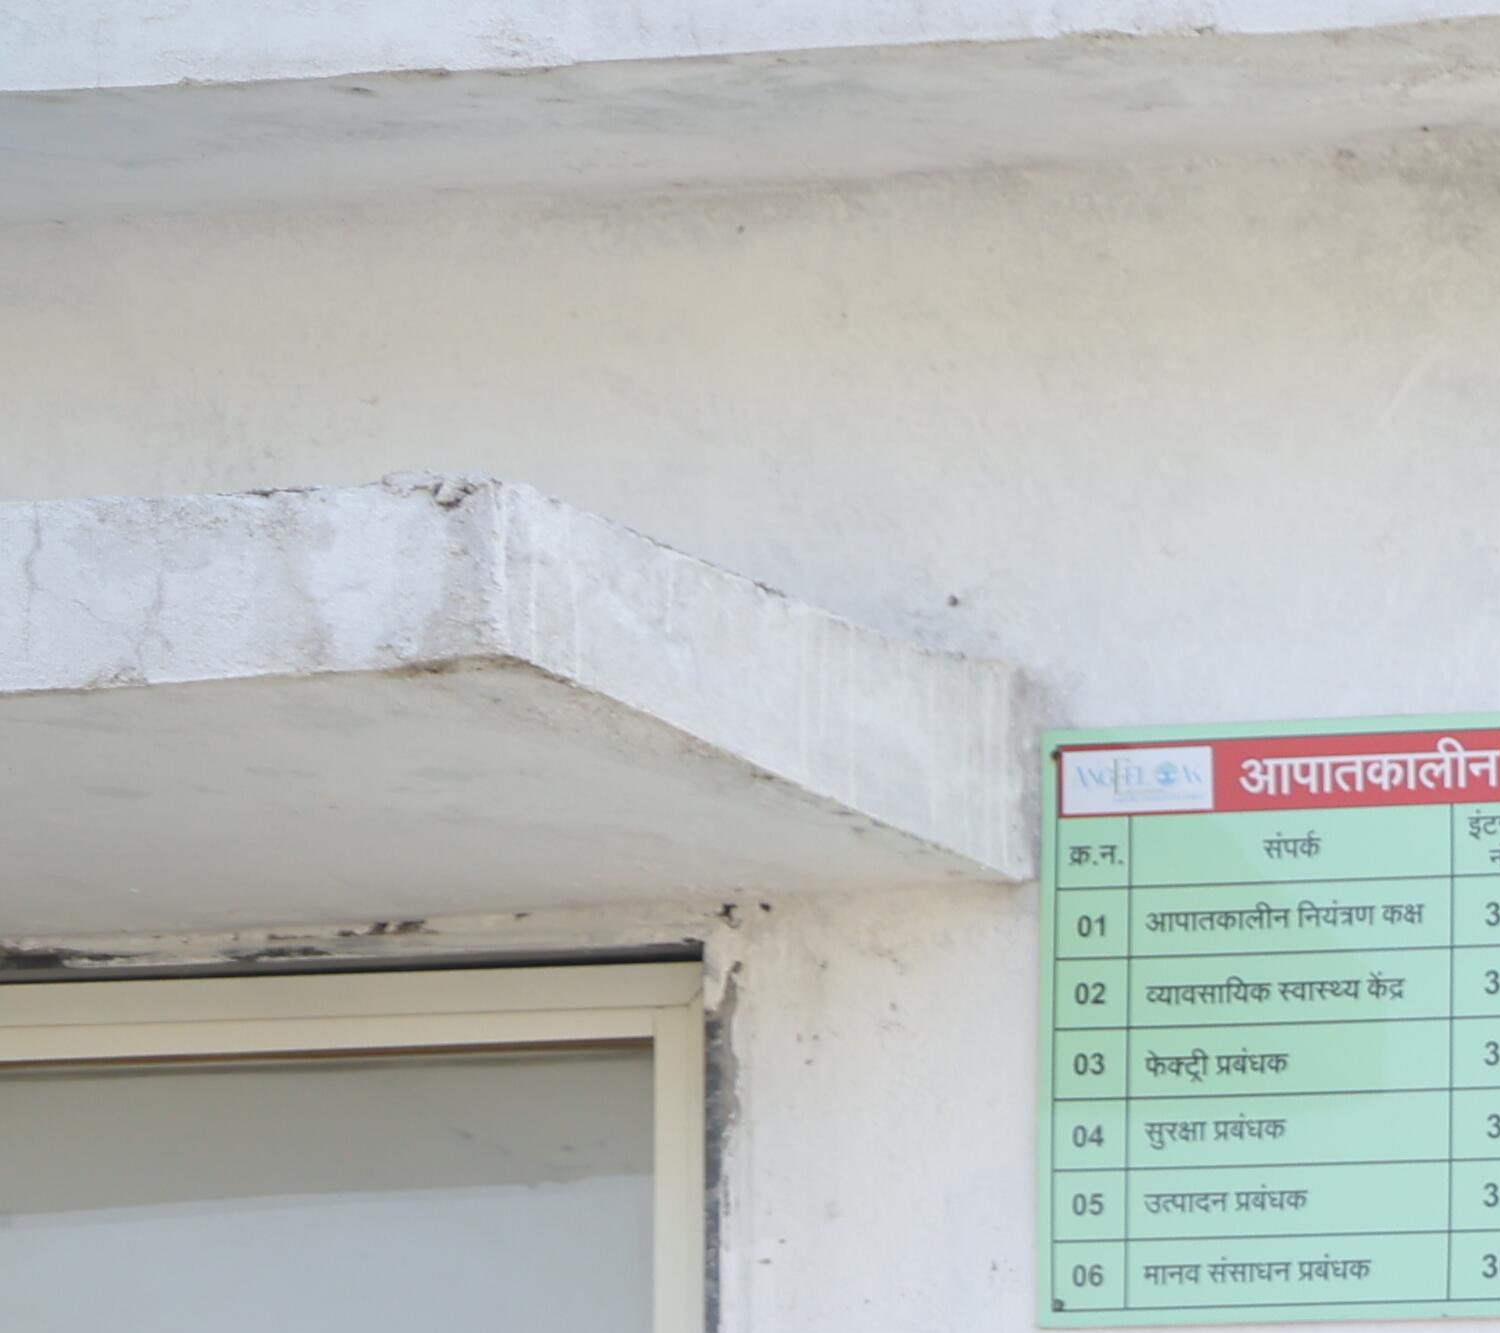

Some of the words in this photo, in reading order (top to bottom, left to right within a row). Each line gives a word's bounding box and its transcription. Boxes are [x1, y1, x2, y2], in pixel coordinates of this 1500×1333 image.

[1262, 829, 1322, 859] संपर्क
[1076, 914, 1106, 939] 01
[1145, 901, 1291, 933] आपातकालीन
[1296, 899, 1376, 929] नियंत्रण
[1381, 903, 1425, 925] कक्ष
[1074, 981, 1107, 1006] 02
[1145, 975, 1273, 1006] व्यावसायिक
[1277, 979, 1362, 1002] स्वास्थ्य
[1366, 971, 1406, 1000] केंद्र
[1073, 1052, 1106, 1076] 03
[1215, 1047, 1289, 1075] प्रबंधक
[1072, 1124, 1105, 1149] 04
[1143, 1120, 1208, 1151] सुरक्षा
[1212, 1112, 1287, 1141] प्रबंधक
[1071, 1192, 1105, 1217] 05
[1143, 1191, 1230, 1215] उत्पादन
[1234, 1183, 1309, 1212] प्रबंधक
[1071, 1263, 1105, 1288] 06
[1142, 1263, 1203, 1286] मानव
[1207, 1256, 1293, 1284] संसाधन
[1297, 1253, 1372, 1281] प्रबंधक
